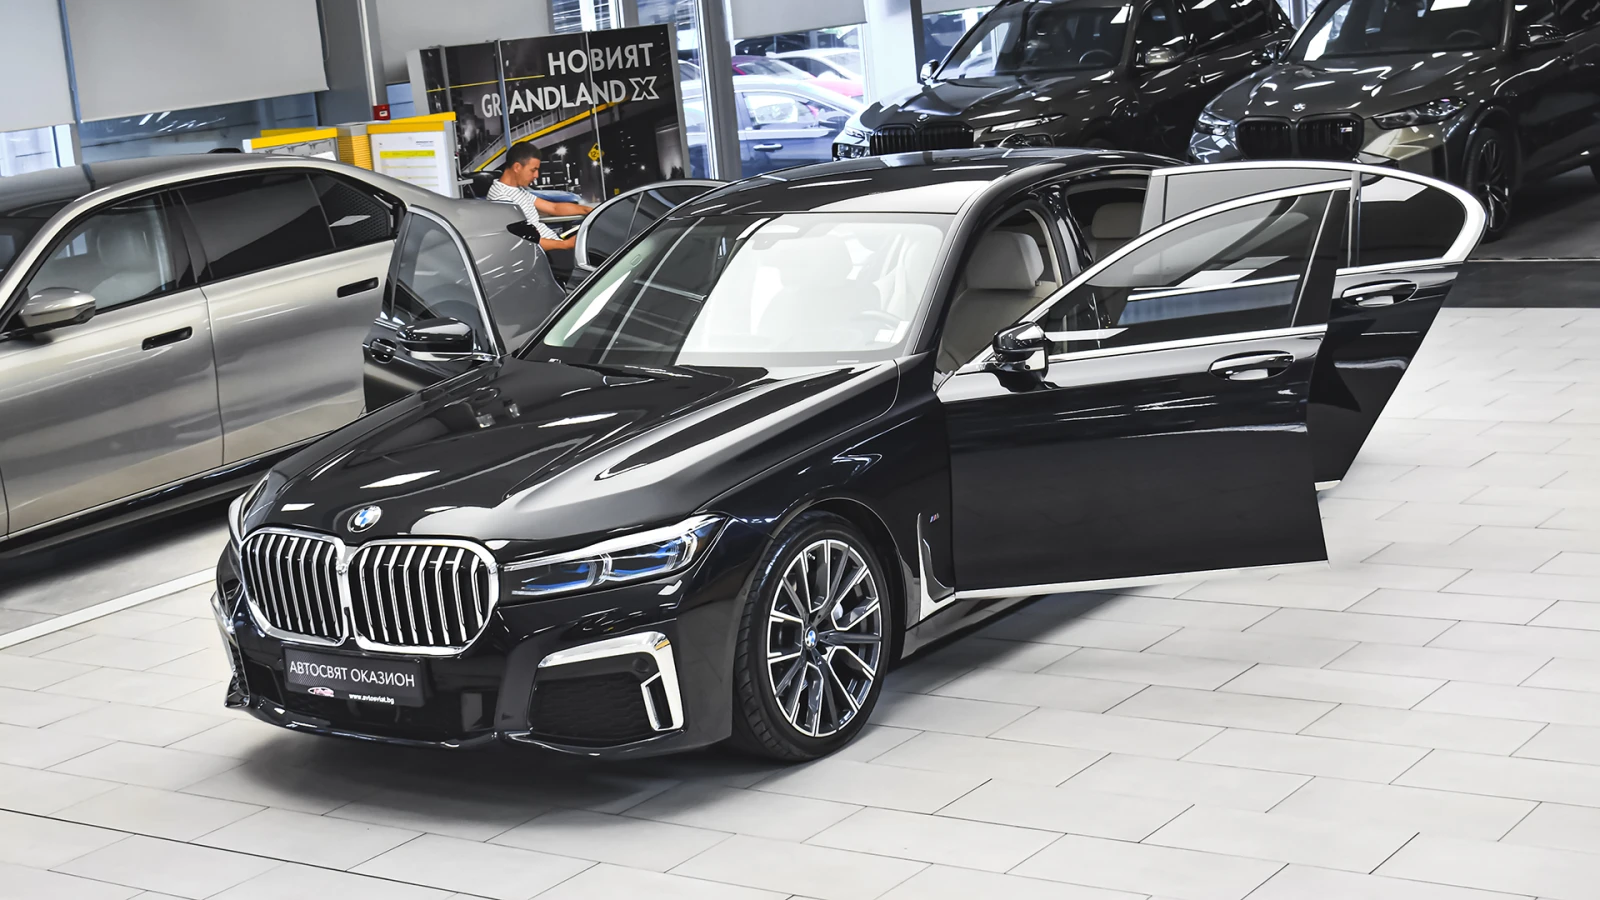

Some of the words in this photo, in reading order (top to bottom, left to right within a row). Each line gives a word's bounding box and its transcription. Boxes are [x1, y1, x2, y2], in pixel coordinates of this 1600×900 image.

[548, 43, 653, 75] НОВИЯТ
[481, 80, 627, 118] GRANDLAND
[629, 76, 660, 101] X
[289, 661, 348, 680] АВТОСВЯТ
[350, 668, 415, 687] ОКАЗИОН
